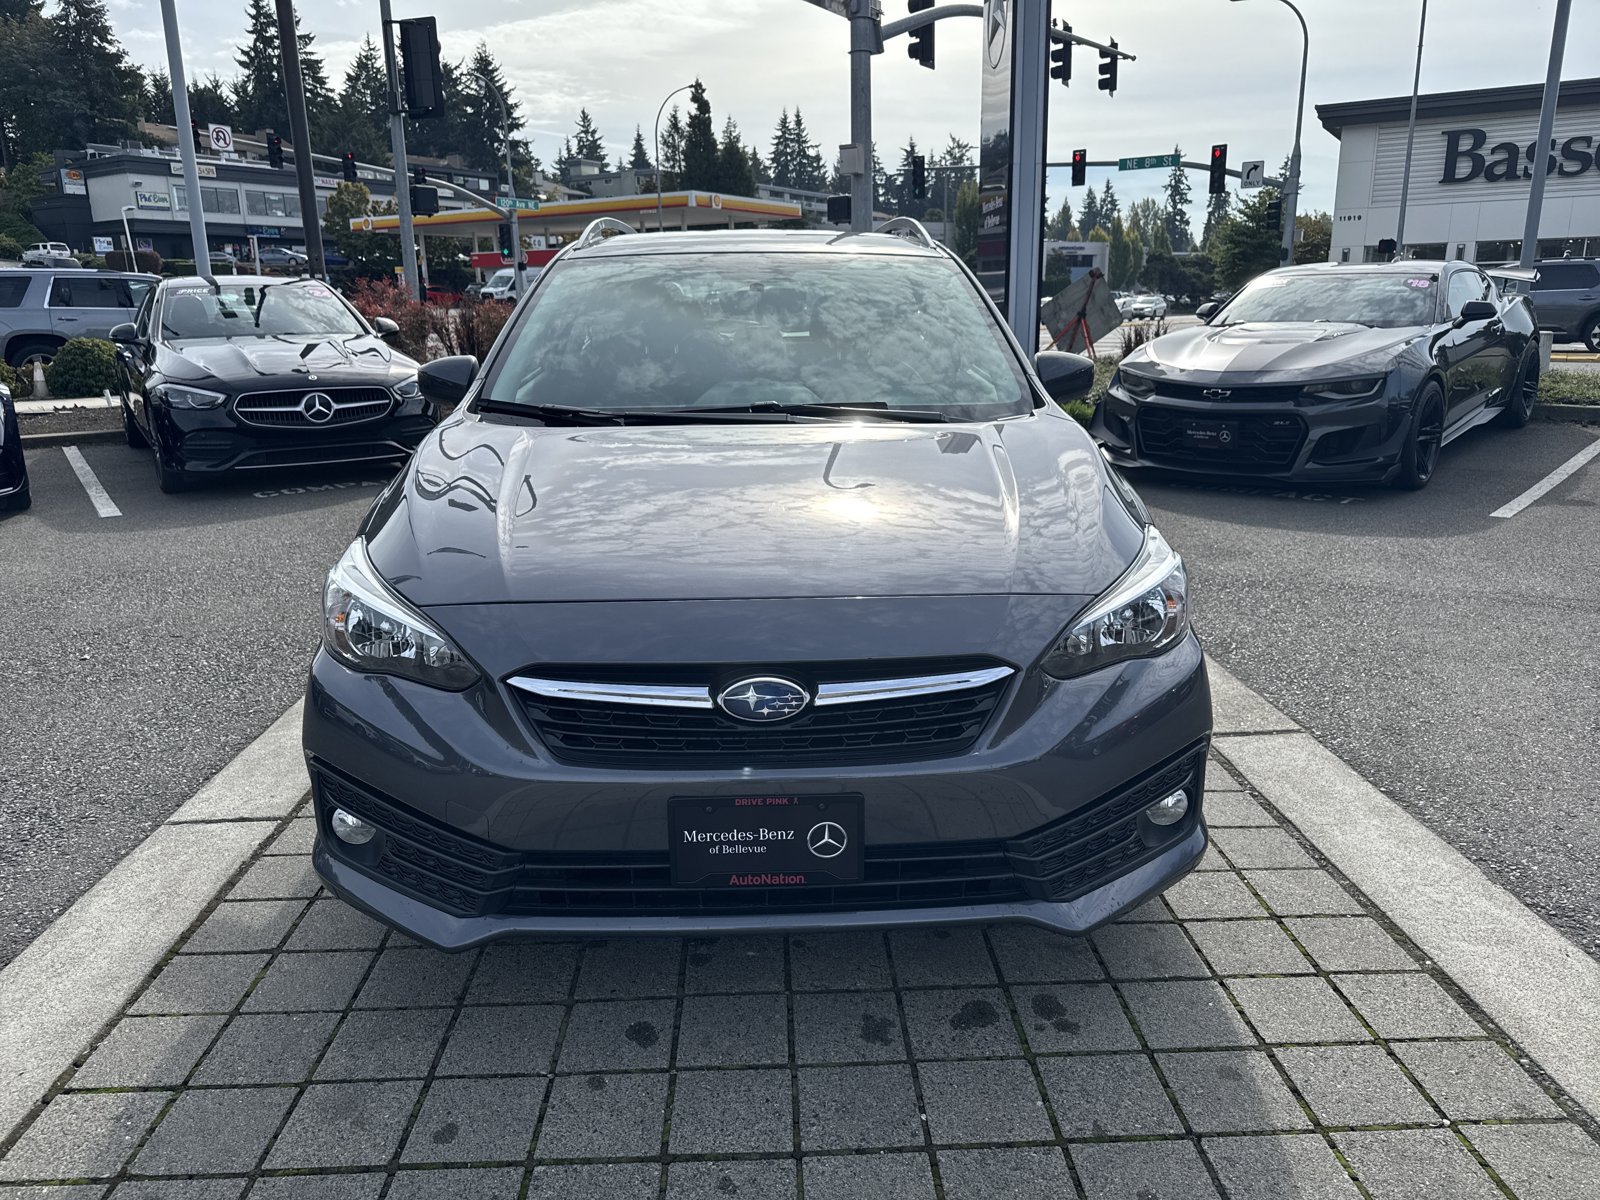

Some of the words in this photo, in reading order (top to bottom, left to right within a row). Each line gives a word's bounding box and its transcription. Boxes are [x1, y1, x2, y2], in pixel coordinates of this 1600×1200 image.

[1126, 159, 1138, 169] NE
[1144, 158, 1157, 168] 8th
[1162, 156, 1172, 166] St
[1438, 128, 1600, 184] Bass
[501, 199, 513, 208] 120th
[516, 200, 526, 209] Ave
[735, 798, 764, 806] DRIVE
[766, 797, 789, 805] PINK
[683, 828, 795, 843] Mercedes-Benz
[709, 846, 719, 854] of
[722, 844, 767, 854] Bellevue
[729, 873, 805, 886] AutoNation
